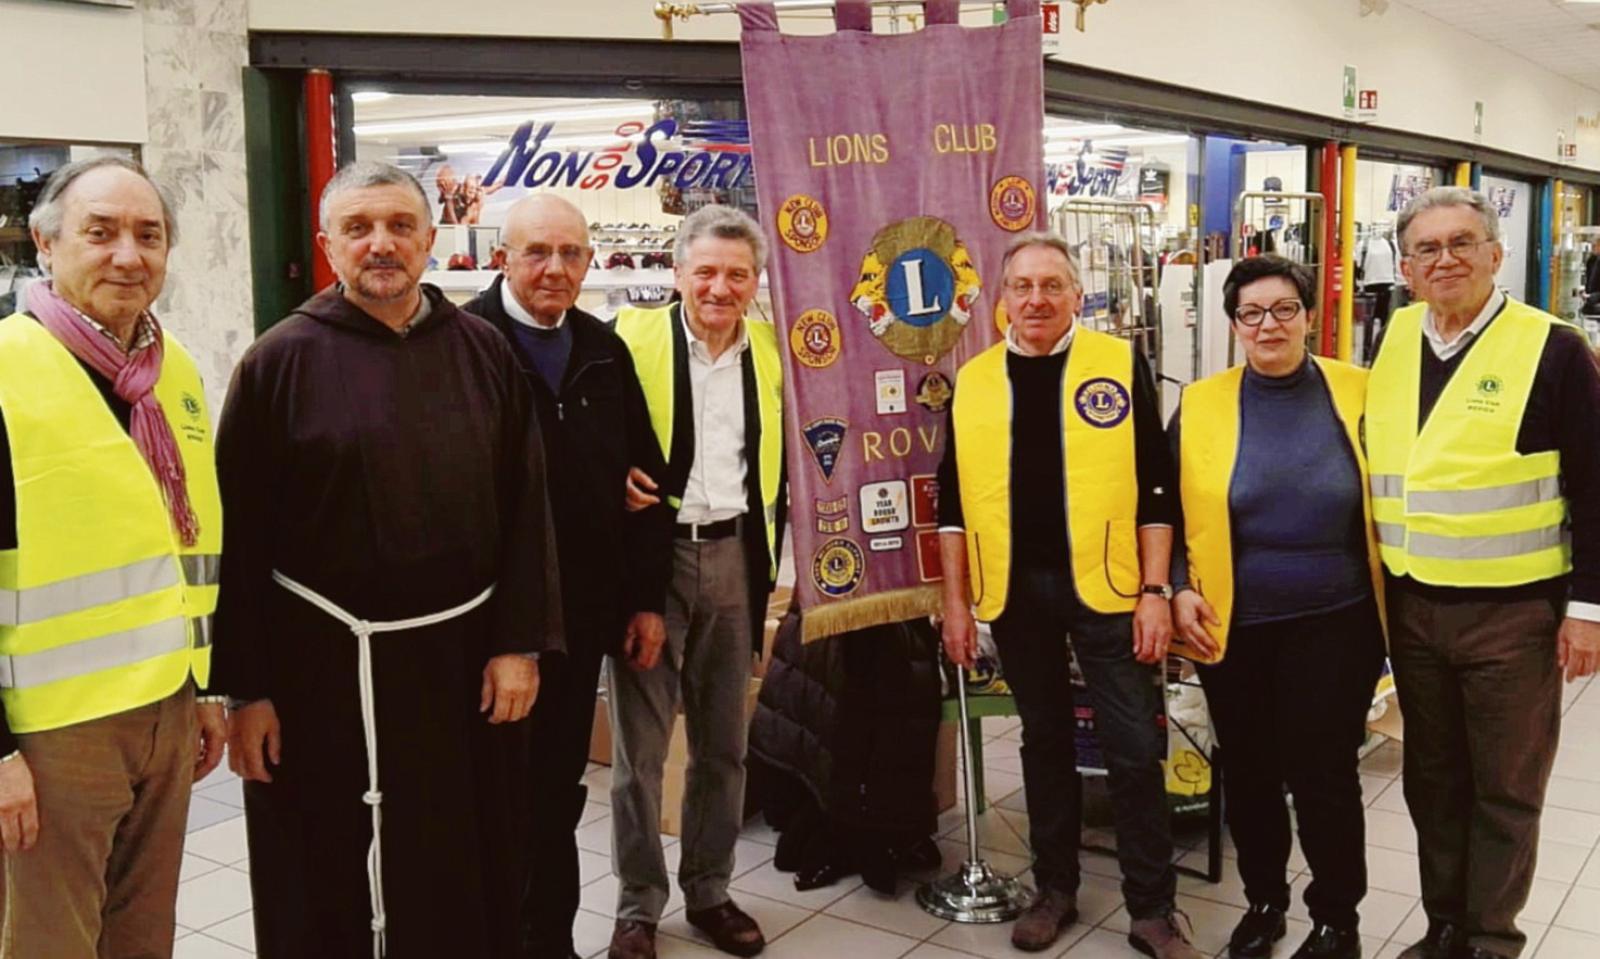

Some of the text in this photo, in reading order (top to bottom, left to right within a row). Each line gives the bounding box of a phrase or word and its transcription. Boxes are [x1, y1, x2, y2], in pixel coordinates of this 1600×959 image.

[580, 121, 644, 190] SOLO
[809, 124, 996, 167] LIONS CLUB
[901, 259, 940, 316] L
[1096, 393, 1110, 408] L
